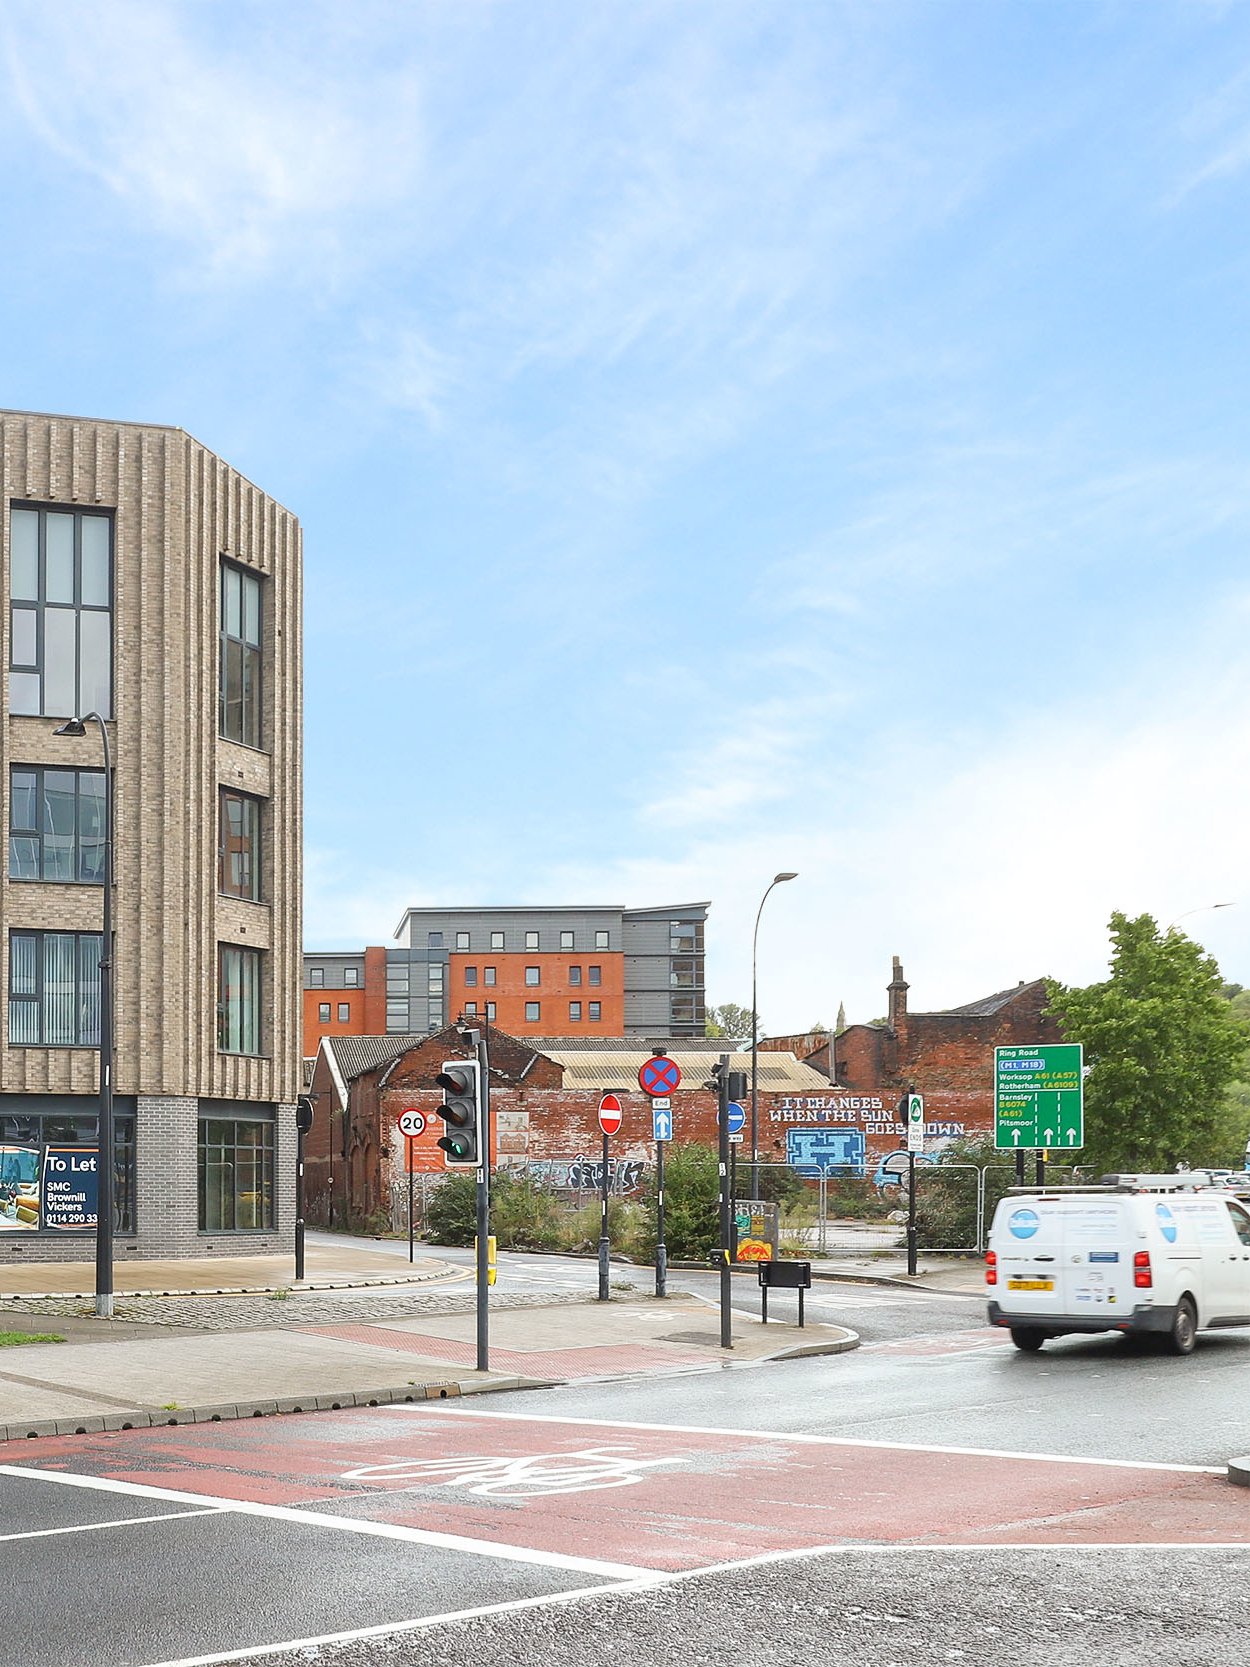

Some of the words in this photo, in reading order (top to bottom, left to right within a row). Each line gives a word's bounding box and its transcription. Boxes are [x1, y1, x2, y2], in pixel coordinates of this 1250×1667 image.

[1022, 1060, 1044, 1068] M18)
[782, 1097, 805, 1109] IT
[806, 1097, 882, 1109] CHANGES
[769, 1110, 819, 1122] WHEN
[821, 1110, 856, 1122] THE
[861, 1110, 894, 1122] SUN
[403, 1117, 423, 1129] 20
[865, 1123, 908, 1135] GOES
[47, 1157, 66, 1171] To
[71, 1157, 97, 1171] Let
[46, 1182, 71, 1191] SMC
[47, 1192, 86, 1201] Brownill
[46, 1202, 83, 1211] Vickers
[47, 1214, 67, 1223] 0114
[69, 1214, 85, 1223] 290
[87, 1214, 98, 1223] 33
